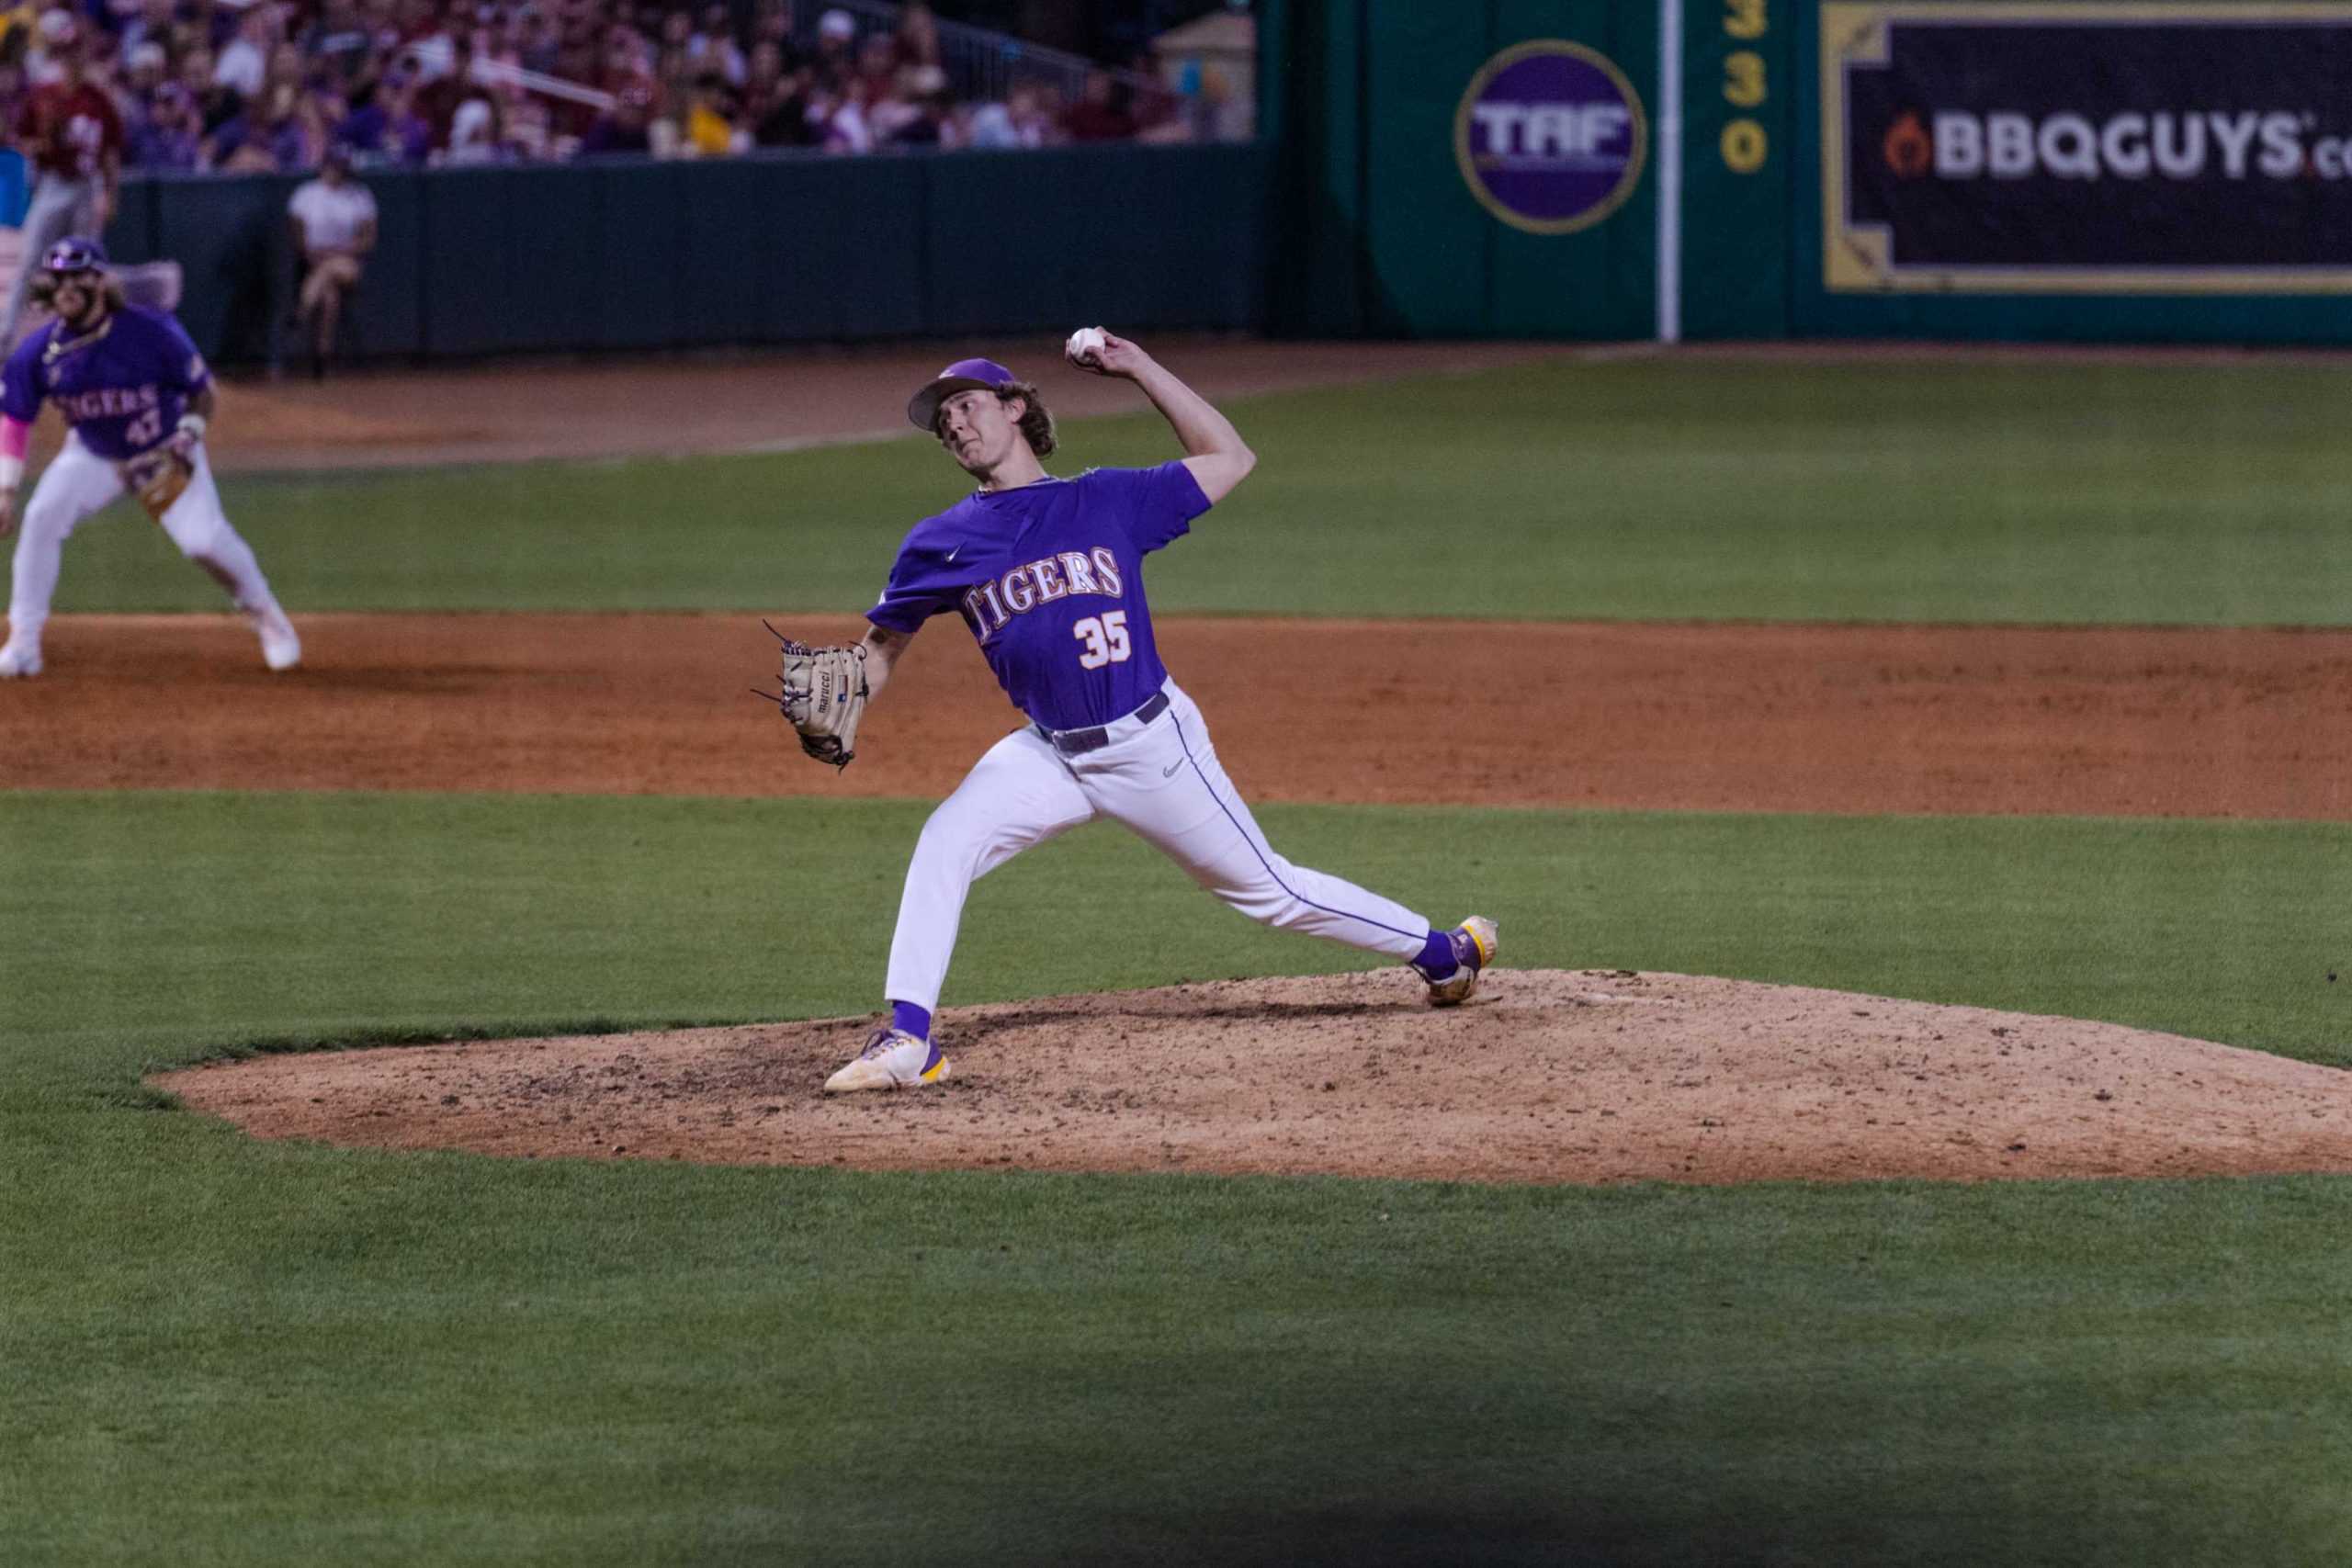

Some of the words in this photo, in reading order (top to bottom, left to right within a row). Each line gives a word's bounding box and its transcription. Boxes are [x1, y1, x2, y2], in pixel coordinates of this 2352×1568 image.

[1475, 102, 1629, 156] TAF
[1933, 111, 2352, 181] BBQGUYS.c
[965, 547, 1123, 647] TIGERS
[1074, 611, 1131, 670] 35
[818, 670, 831, 714] marucci
